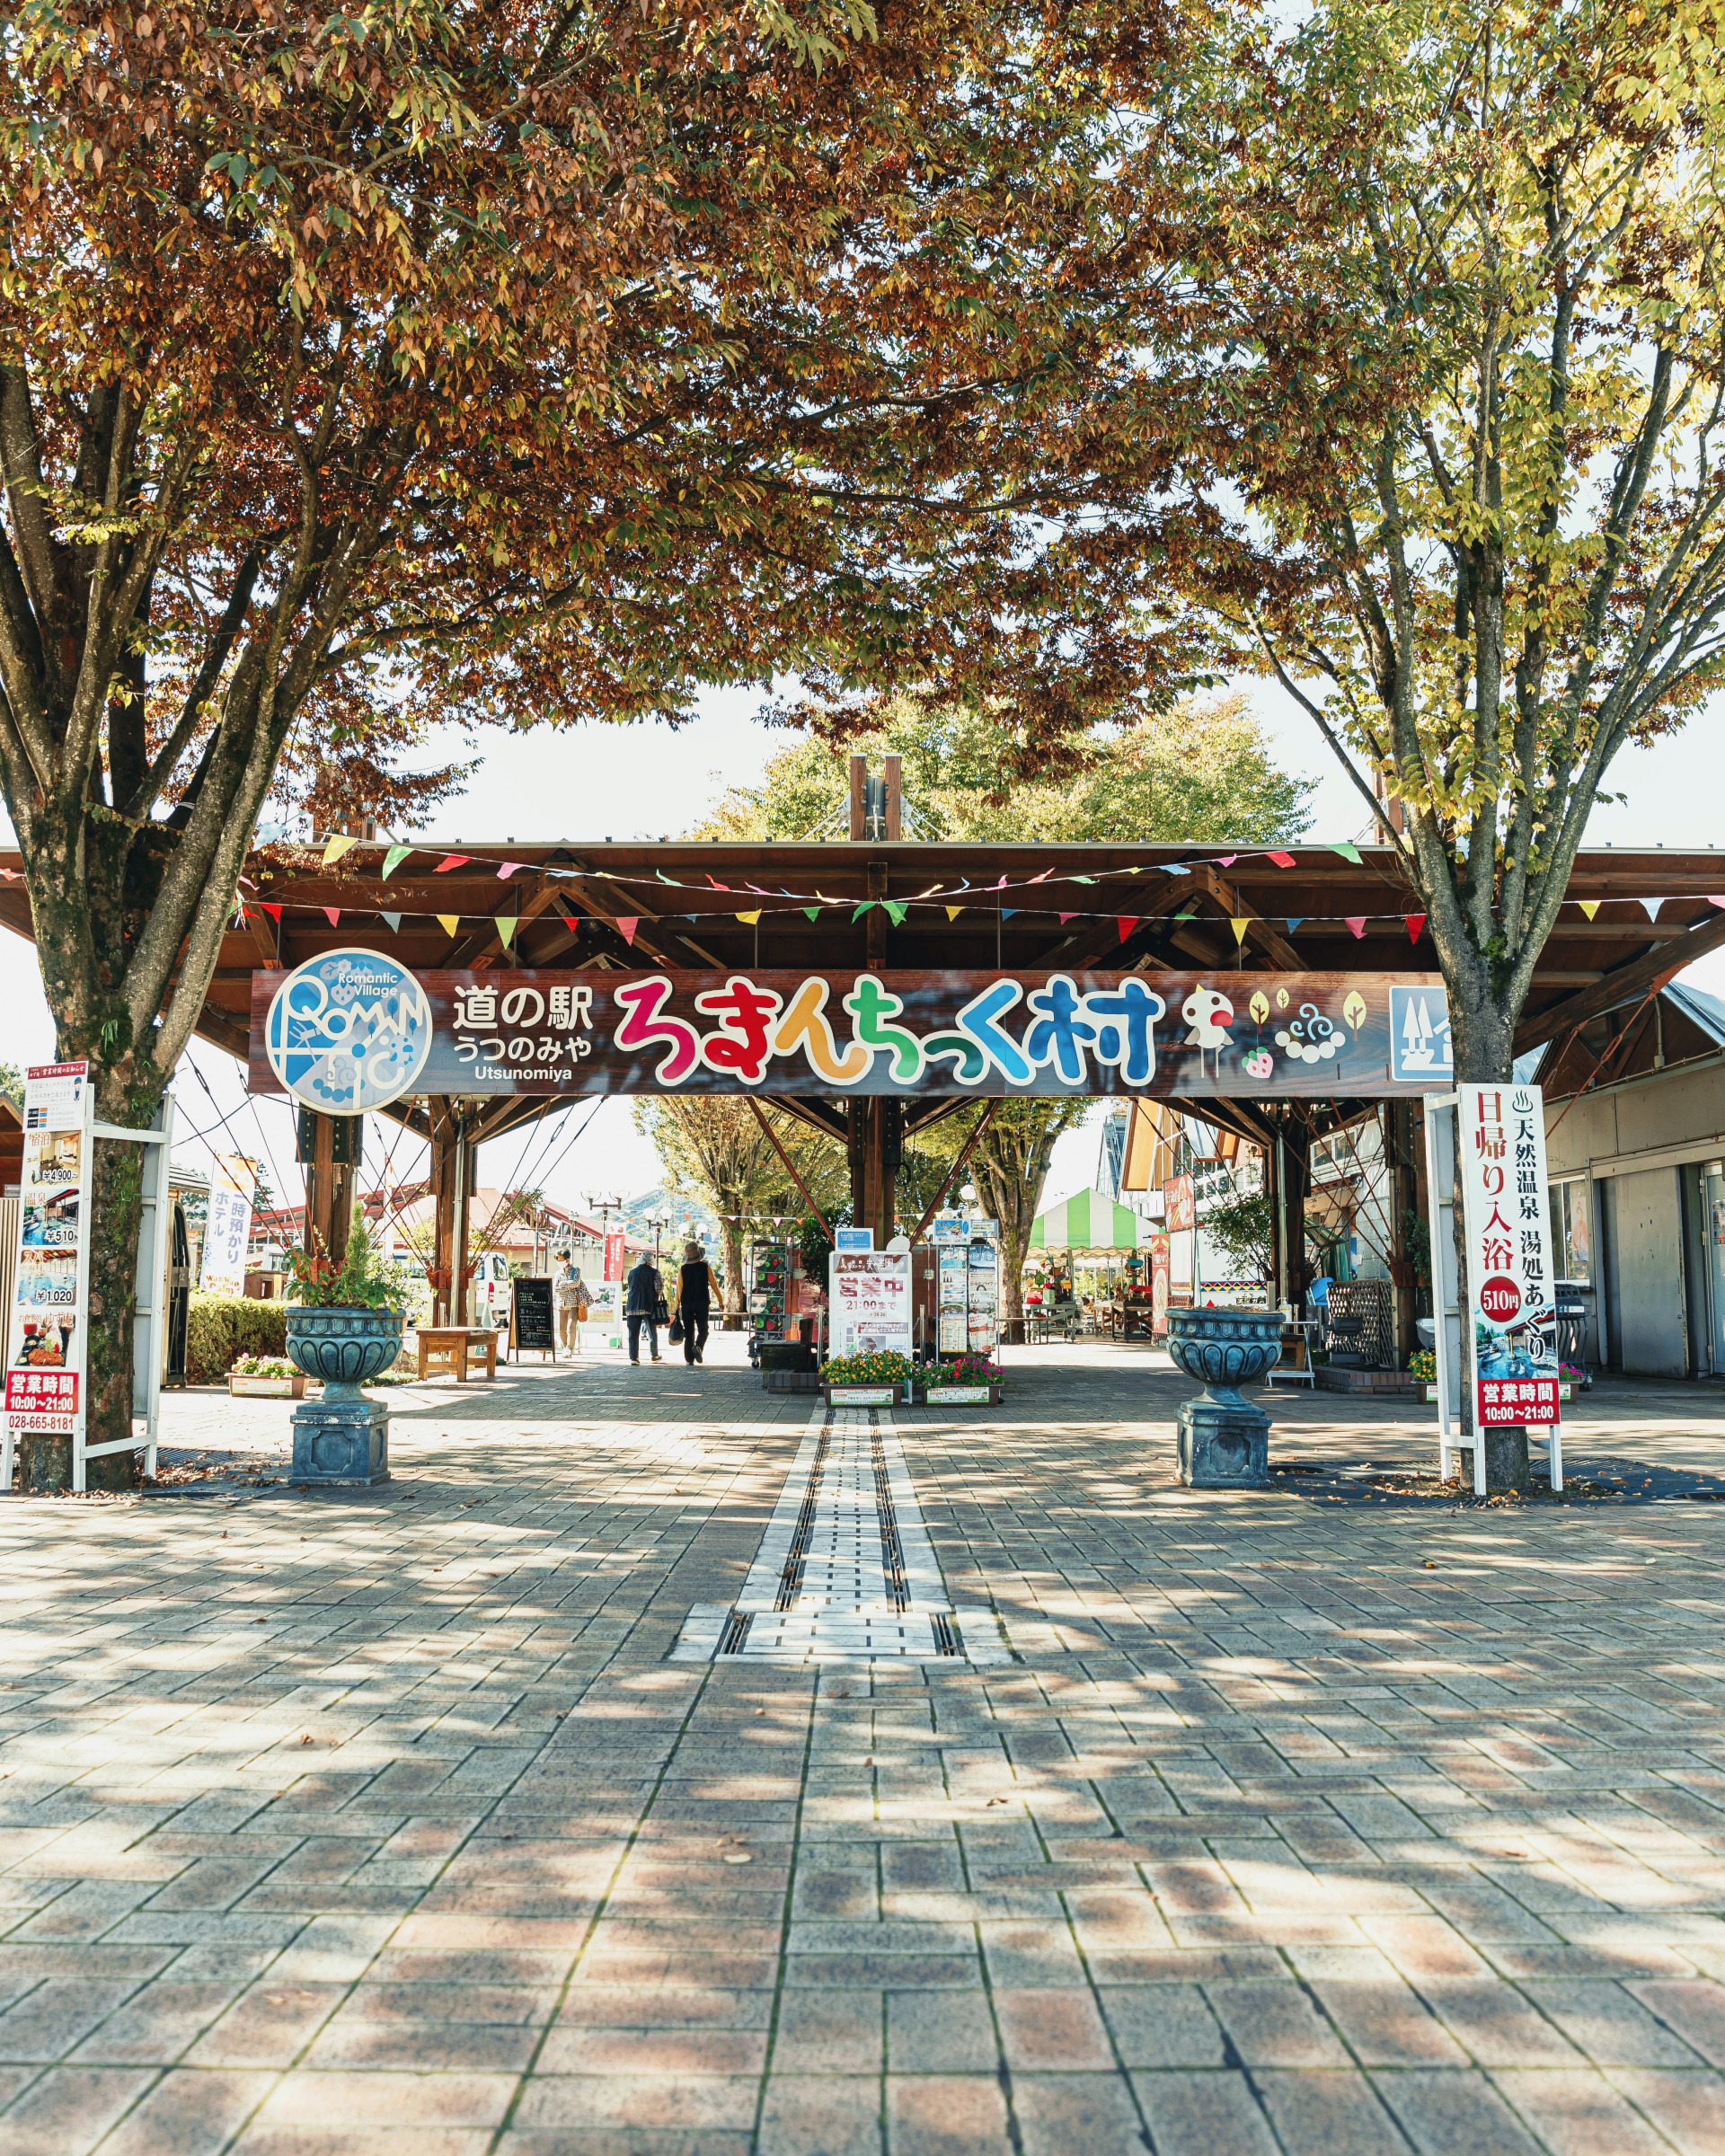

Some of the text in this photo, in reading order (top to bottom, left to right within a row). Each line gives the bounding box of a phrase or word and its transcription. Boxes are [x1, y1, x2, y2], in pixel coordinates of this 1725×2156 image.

[338, 972, 398, 984] Romantic
[354, 985, 398, 998] Village
[452, 985, 594, 1030] 道の駅
[615, 974, 1166, 1087] ろまんちっく村
[454, 1036, 592, 1063] うつのみや
[474, 1065, 573, 1082] Utsunomiya
[1475, 1091, 1516, 1271] 日帰り入浴
[27, 1192, 47, 1206] 温泉
[214, 1191, 229, 1237] ホテル
[47, 1230, 75, 1242] ¥510
[227, 1192, 246, 1264] 一時預かり
[1513, 1118, 1548, 1361] 天然温泉 湯処あぐり
[838, 1277, 904, 1298] 営業中
[845, 1299, 897, 1311] 21:00まで
[1482, 1289, 1519, 1311] 510円
[11, 1374, 74, 1395] 営業時間
[1483, 1383, 1553, 1403] 営業時間
[9, 1415, 74, 1431] 028-665-8181
